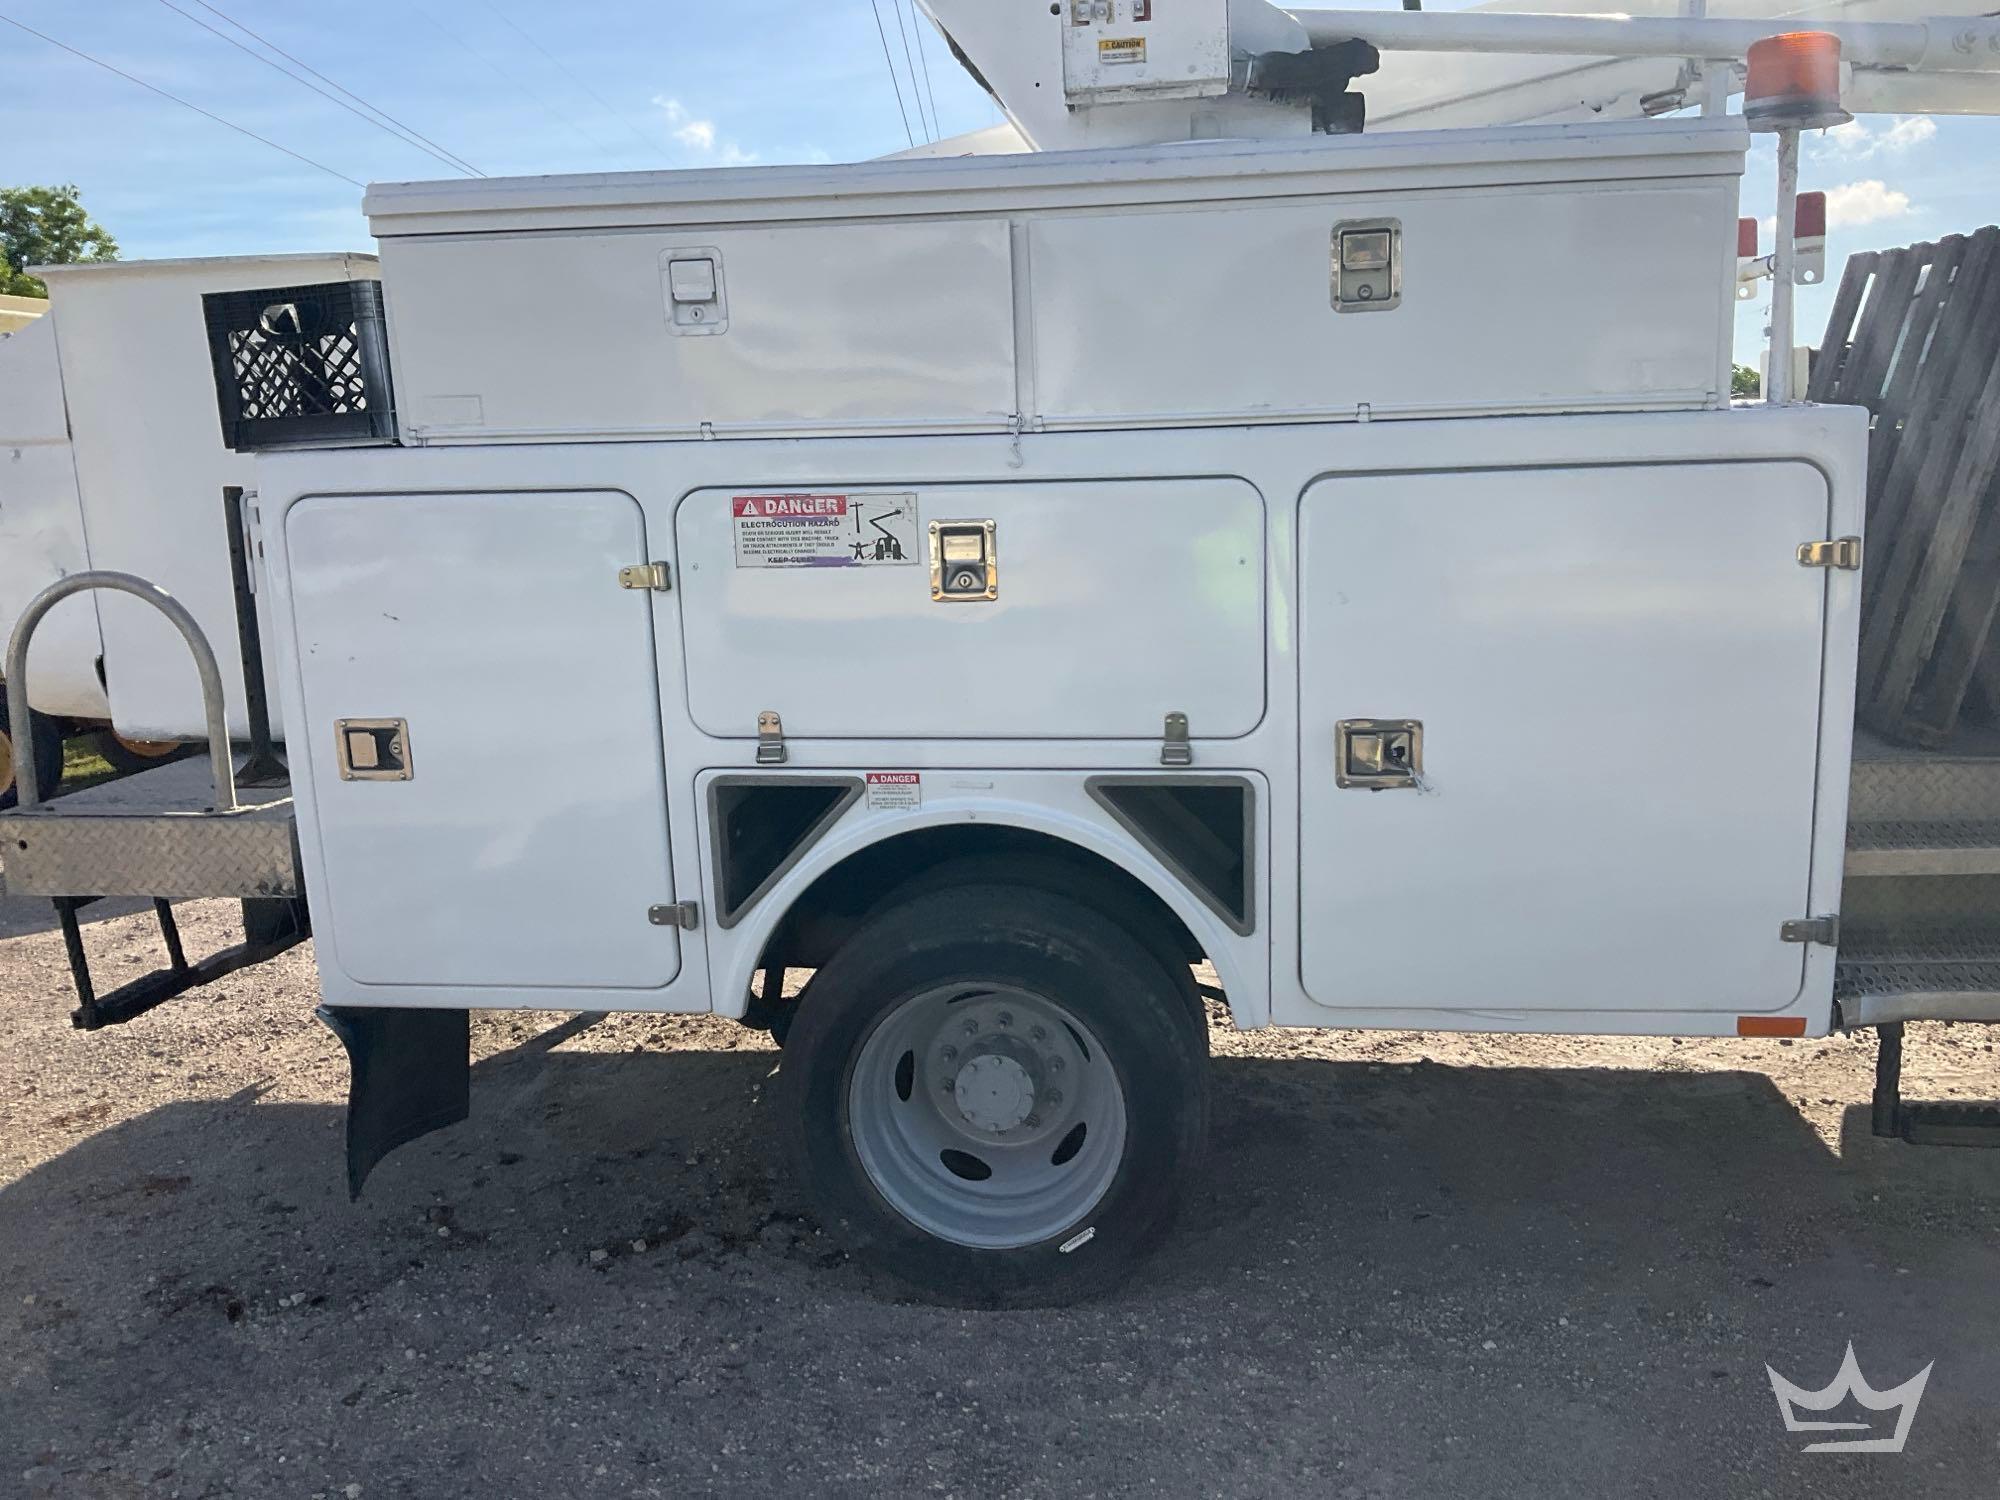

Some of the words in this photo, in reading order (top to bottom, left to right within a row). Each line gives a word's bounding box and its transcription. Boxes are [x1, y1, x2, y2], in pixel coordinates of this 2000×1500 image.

[1112, 40, 1140, 49] CAUTION
[765, 499, 838, 514] DANGER
[808, 519, 840, 527] HAZARD
[880, 775, 917, 783] DANGER
